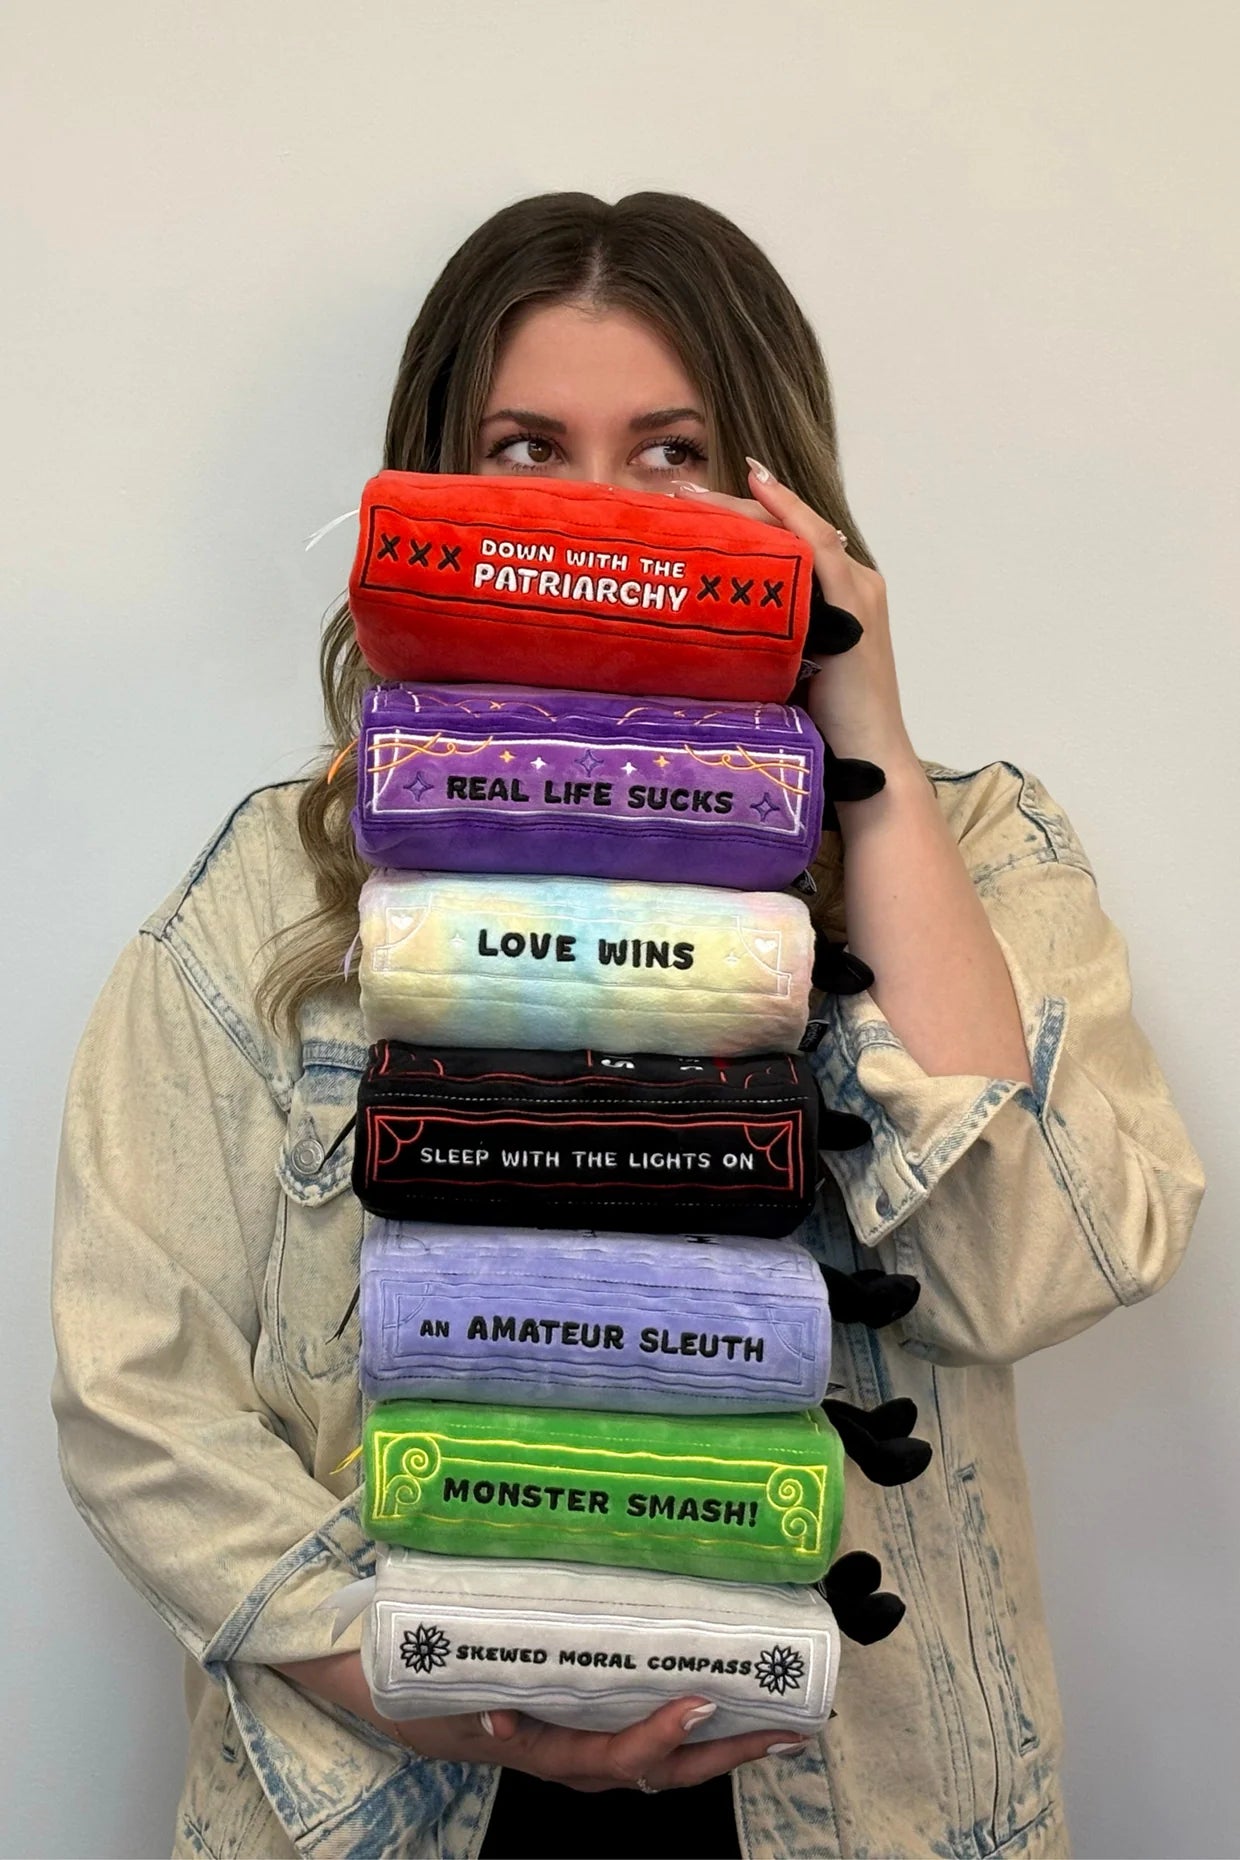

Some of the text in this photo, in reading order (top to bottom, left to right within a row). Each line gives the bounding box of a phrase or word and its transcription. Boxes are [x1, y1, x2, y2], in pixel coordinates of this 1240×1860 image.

[481, 538, 685, 578] DOWN WITH THE
[473, 563, 688, 612] PATRIARCHY
[446, 775, 734, 815] REAL LIFE SUCKS
[478, 929, 695, 970] LOVE WINS
[420, 1147, 753, 1170] SLEEP WITH THE LIGHTS ON
[420, 1315, 764, 1363] AN AMATEUR SLEUTH
[443, 1477, 759, 1528] MONSTER SMASH!
[455, 1644, 751, 1676] SKEWED MORAL COMPASS
